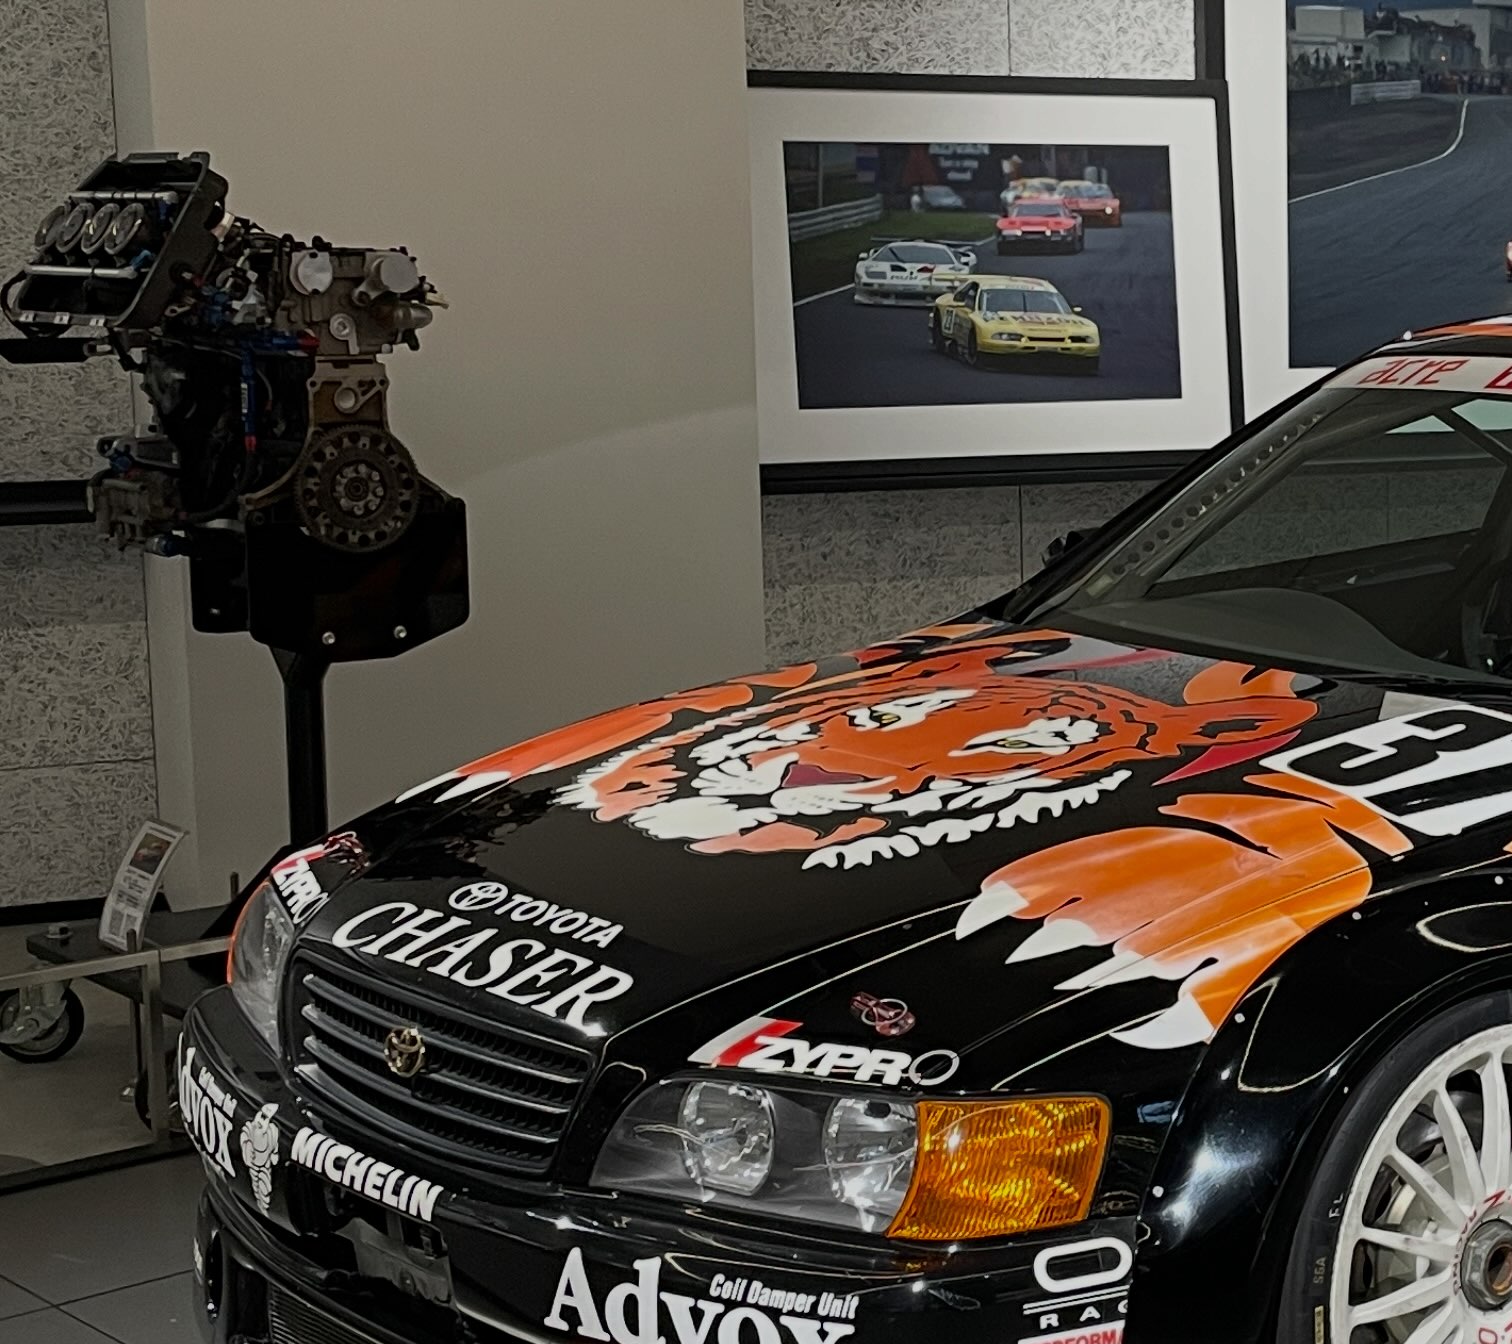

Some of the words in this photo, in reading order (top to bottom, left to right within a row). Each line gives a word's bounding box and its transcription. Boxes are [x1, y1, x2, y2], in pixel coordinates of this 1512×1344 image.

[503, 894, 624, 948] TOYOTA
[333, 902, 634, 1037] CHASER
[178, 1031, 236, 1178] dvox
[290, 1126, 443, 1222] MICHELIN
[709, 1273, 746, 1302] Coil
[747, 1280, 817, 1313] Damper
[817, 1291, 860, 1320] Unit
